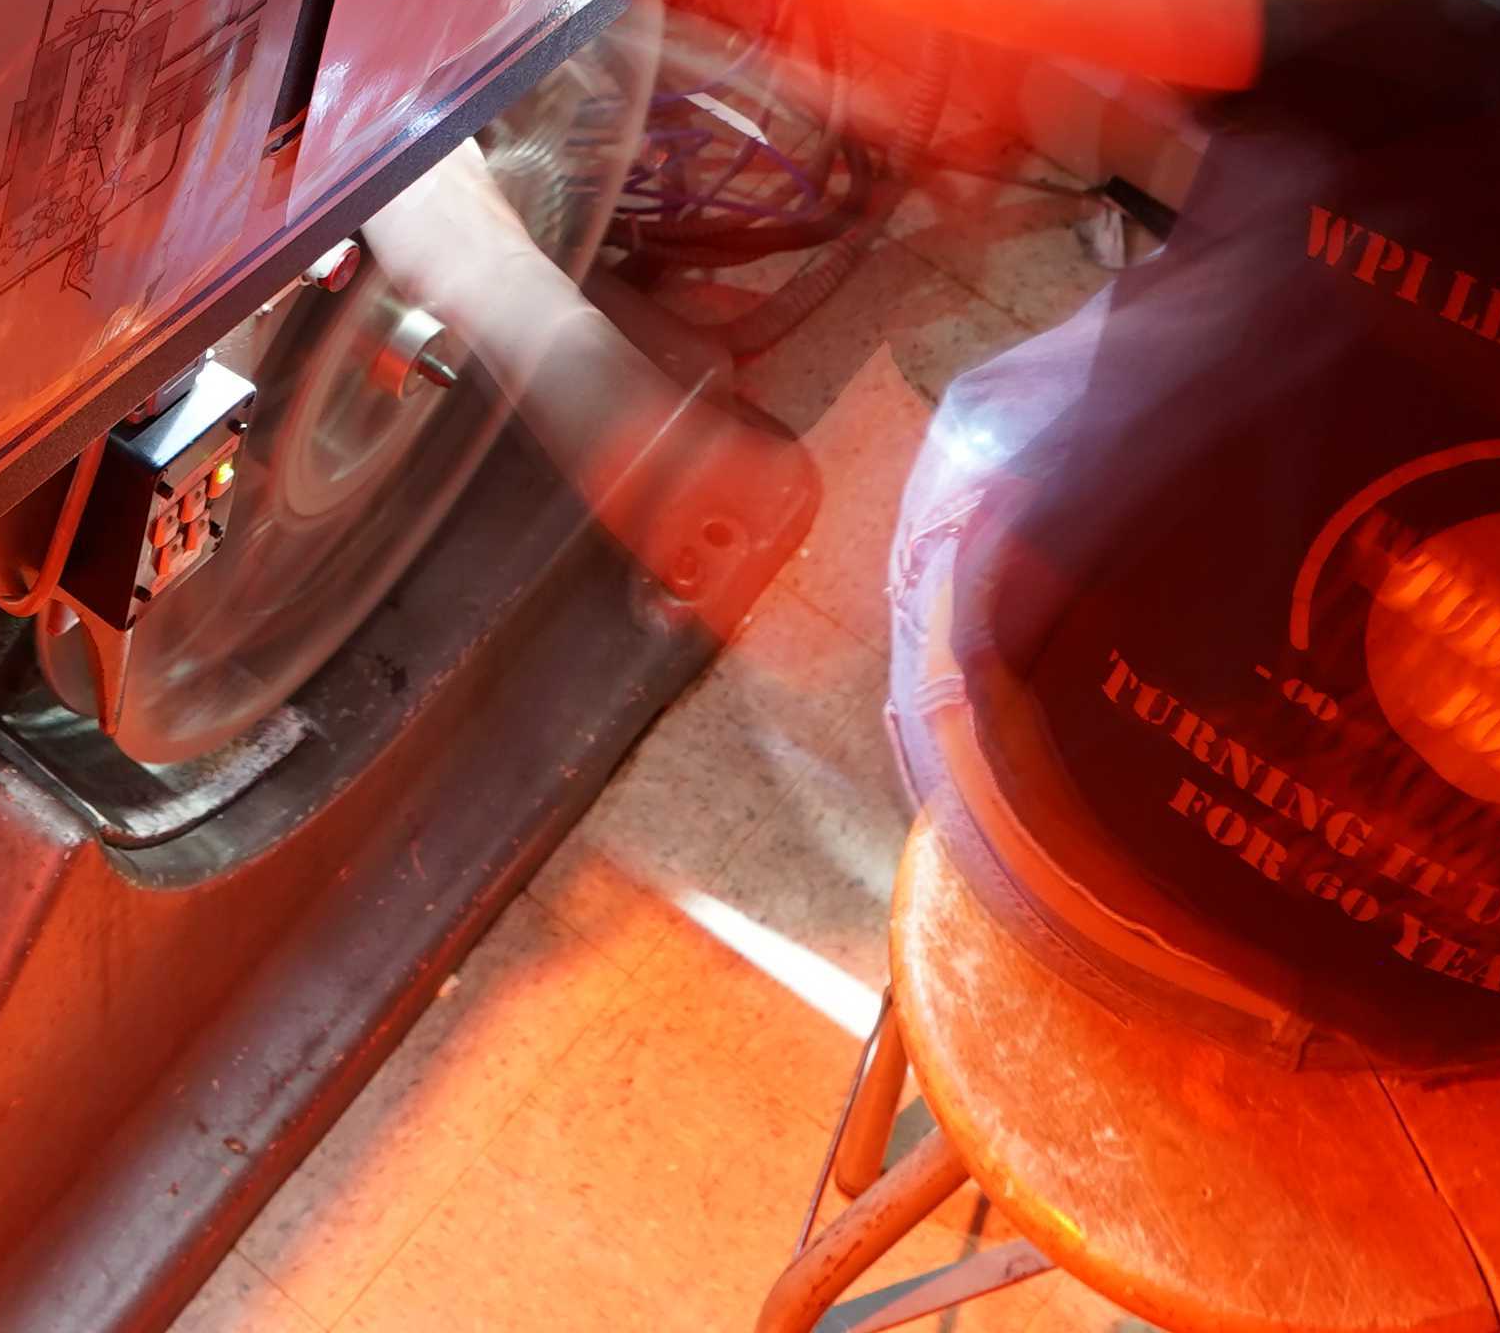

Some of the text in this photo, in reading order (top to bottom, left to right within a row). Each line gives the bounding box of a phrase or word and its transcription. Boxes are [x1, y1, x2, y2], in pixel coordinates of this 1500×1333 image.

[1304, 204, 1440, 306] WPI
[1101, 649, 1373, 859] TURNING
[1378, 842, 1457, 899] IT
[1166, 776, 1289, 882] FOR
[1304, 870, 1380, 923] 60
